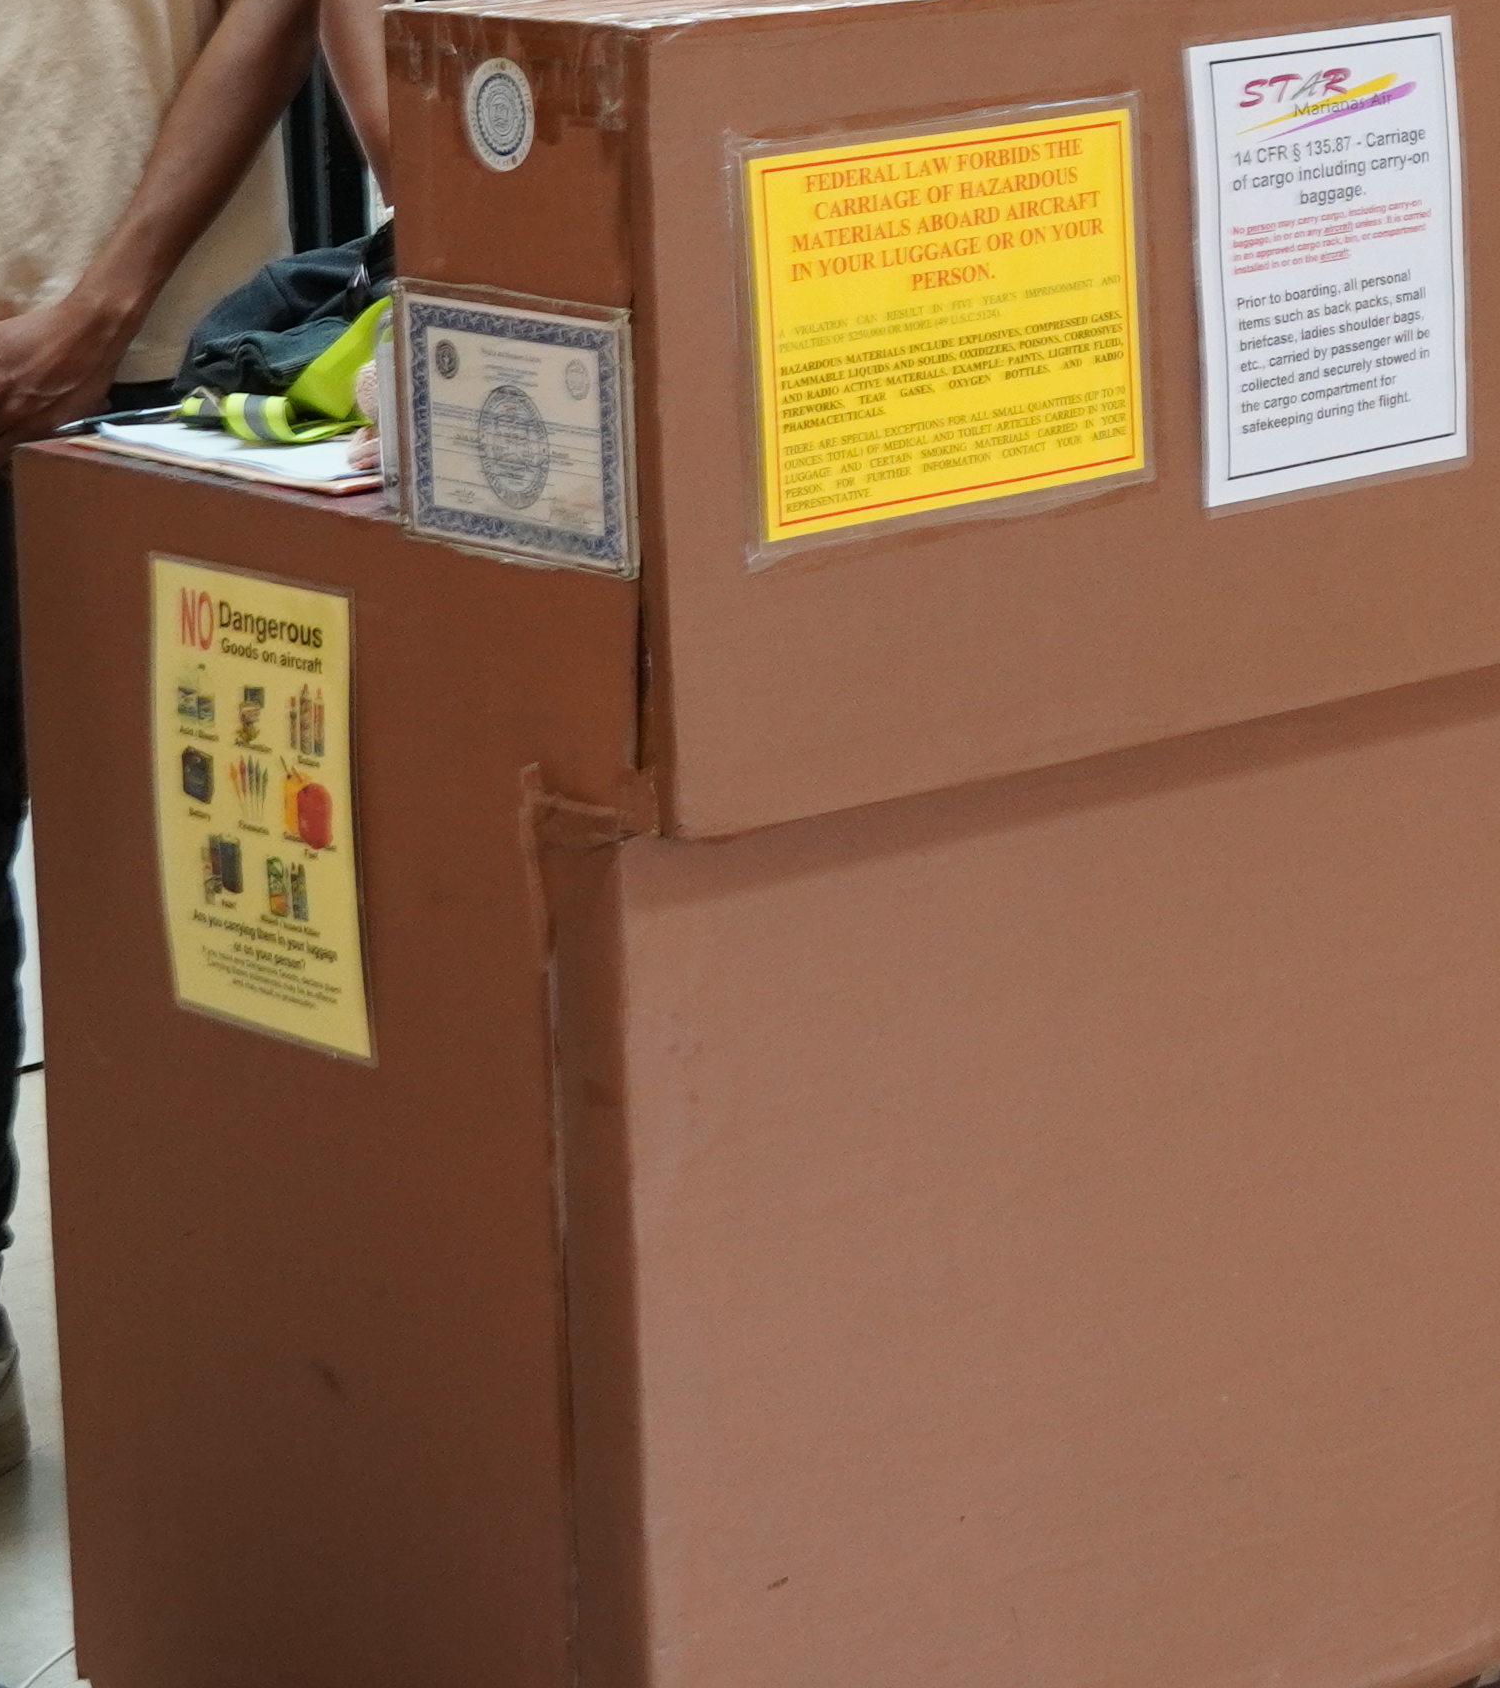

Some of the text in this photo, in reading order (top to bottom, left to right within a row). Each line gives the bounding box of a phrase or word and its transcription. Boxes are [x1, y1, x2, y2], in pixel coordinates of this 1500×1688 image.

[1238, 67, 1353, 108] STAR
[1293, 91, 1393, 117] Marianas Air
[804, 138, 1084, 193] FEDERAL LAW FORBIDS THE
[1233, 127, 1426, 167] 14 CFR § 135.87 Carriage
[1233, 150, 1430, 192] of cargo including carry-on
[814, 165, 1078, 220] CARRIAGE OF HAZARDOUS
[1299, 183, 1367, 206] baggage.
[790, 190, 1101, 254] MATERIALS ABOARD AIRCRAFT
[790, 217, 1104, 282] IN YOUR LUGGAGE OR ON YOUR
[911, 262, 996, 293] PERSON.
[1236, 268, 1412, 311] Prior to boarding, all personal
[181, 586, 324, 651] NO Dangerous
[221, 637, 323, 674] Goods on aircraft
